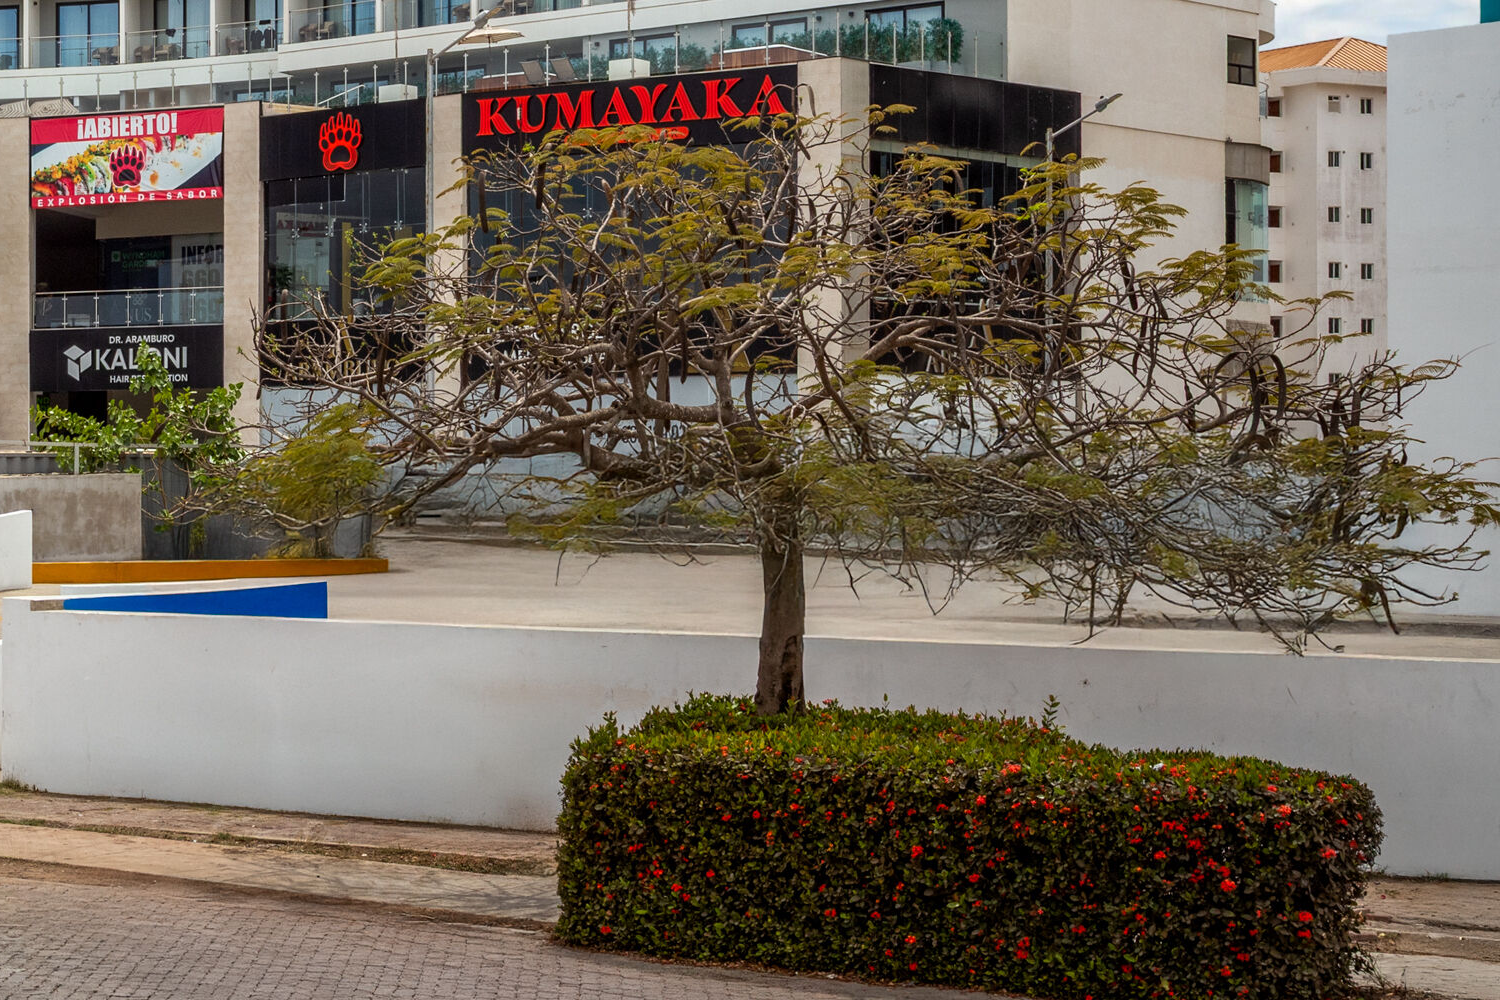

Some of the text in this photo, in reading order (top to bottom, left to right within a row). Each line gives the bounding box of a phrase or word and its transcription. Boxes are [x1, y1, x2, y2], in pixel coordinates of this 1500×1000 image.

[476, 74, 789, 137] KUMAYAKA
[76, 112, 178, 140] ¡ABIERTO!
[37, 189, 219, 207] EXPLOSIÓN DE SABOR
[109, 334, 175, 344] DR. ARAMBURO
[109, 375, 130, 383] HAIR
